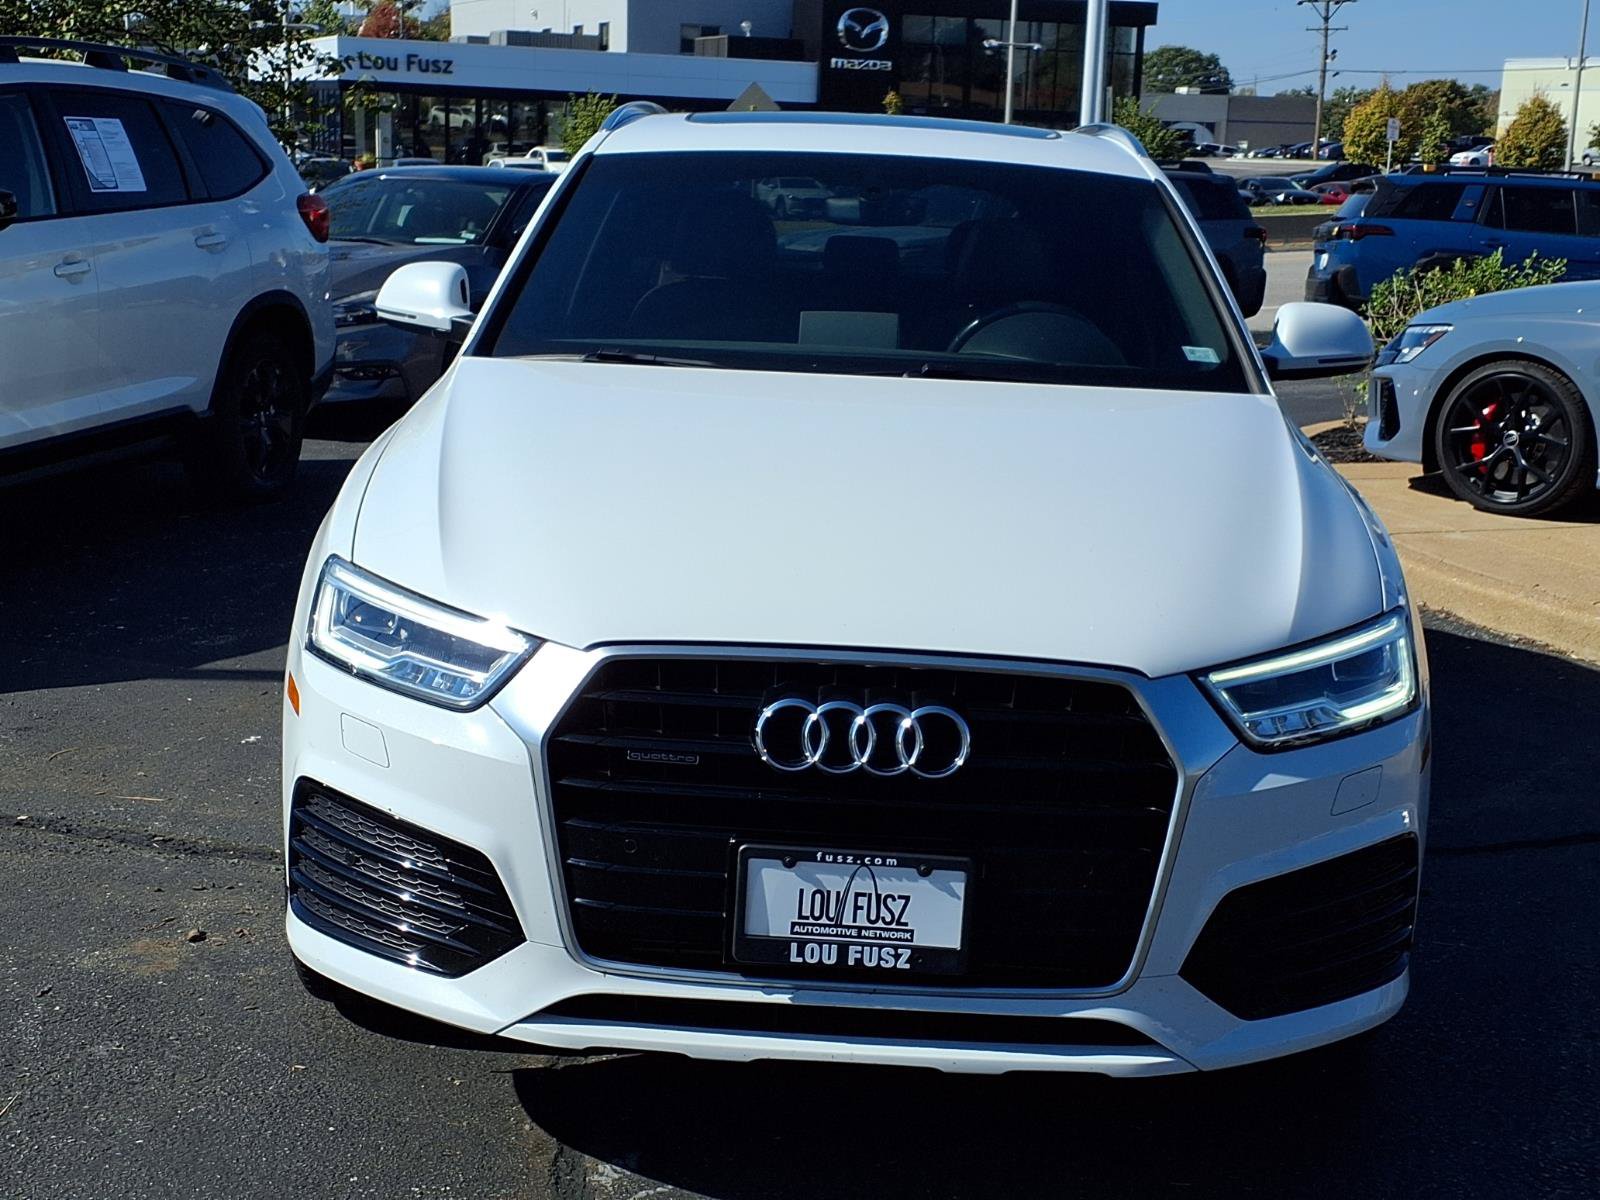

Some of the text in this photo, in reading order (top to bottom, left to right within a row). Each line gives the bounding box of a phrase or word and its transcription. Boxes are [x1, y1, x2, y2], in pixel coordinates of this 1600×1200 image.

[358, 51, 454, 74] Lou Fusz
[630, 752, 696, 763] quattro
[816, 851, 898, 866] fusz.com
[797, 888, 911, 926] LOU FUSZ
[793, 925, 912, 940] AUTOMOTIVE NETWORK
[790, 942, 912, 969] LOU FUSZ
